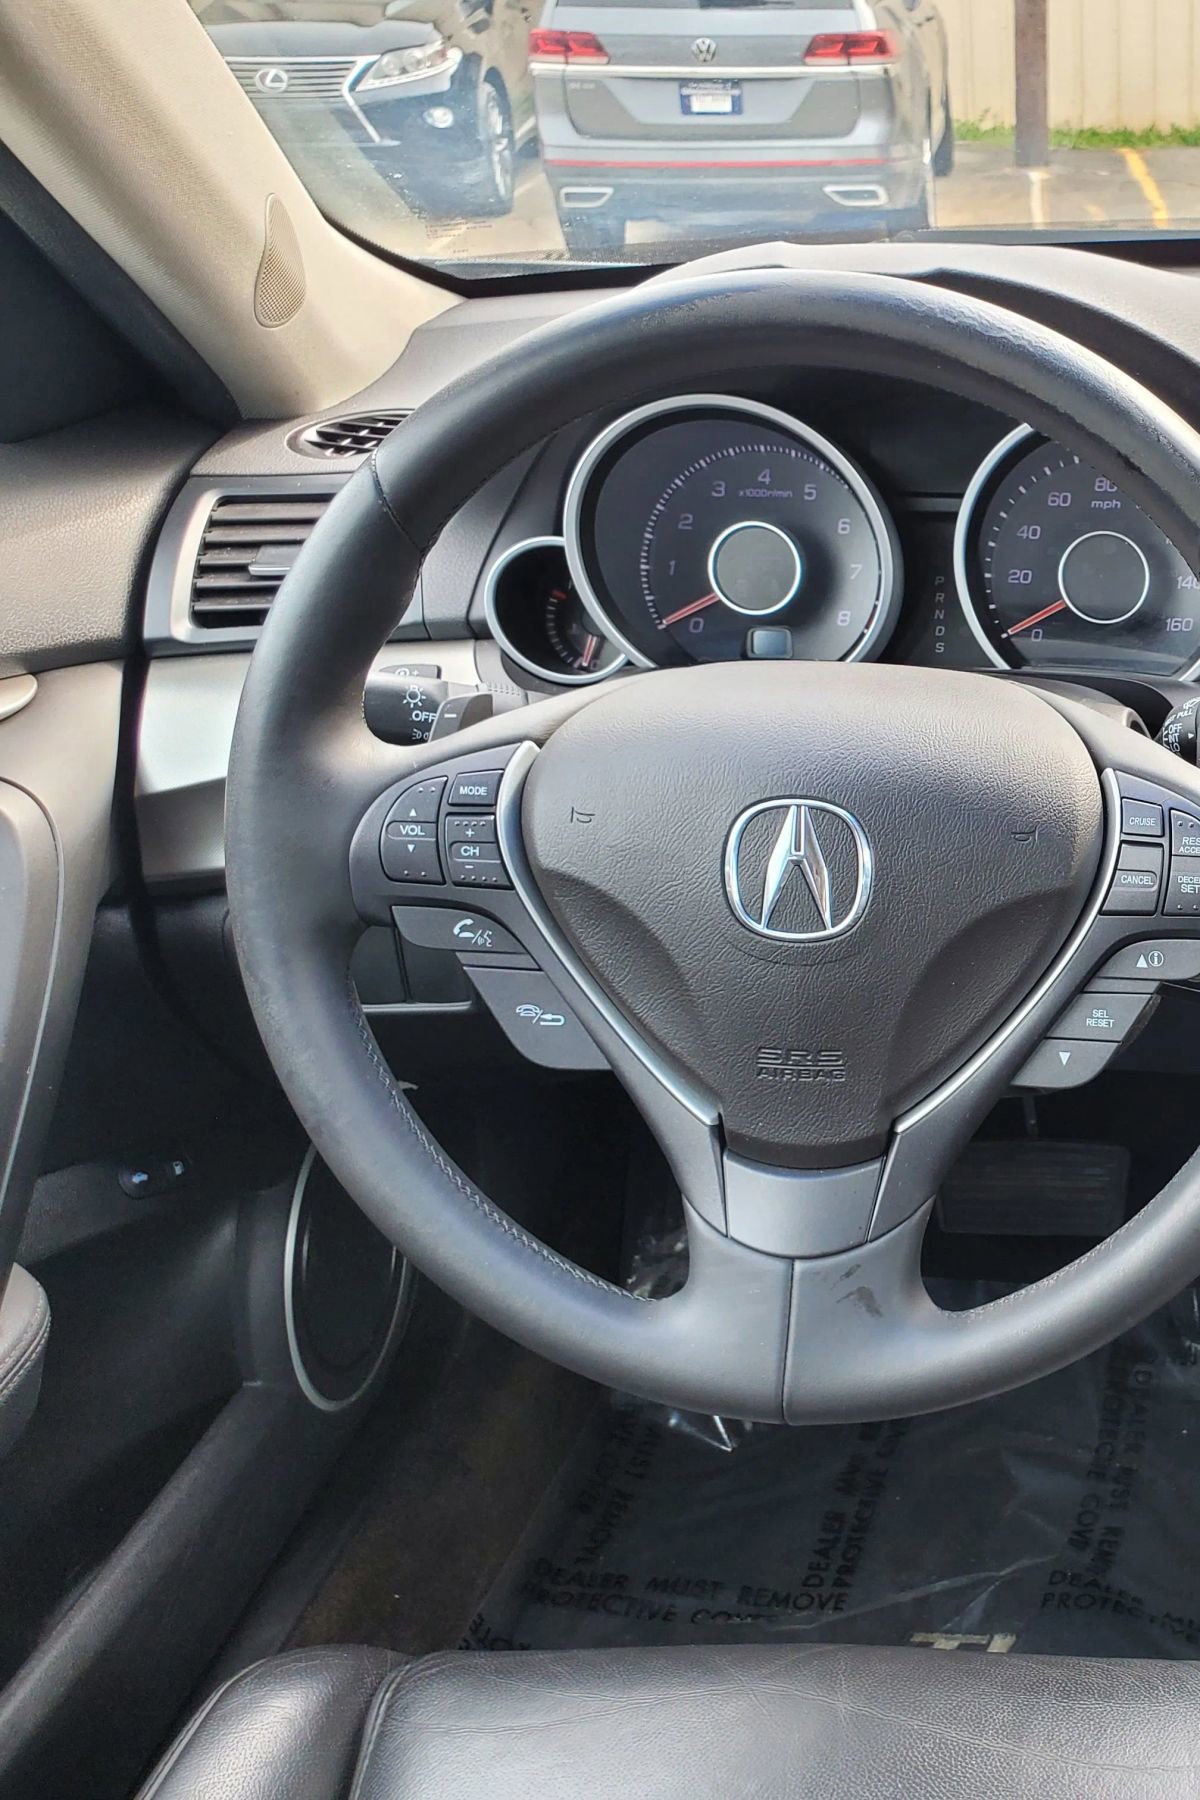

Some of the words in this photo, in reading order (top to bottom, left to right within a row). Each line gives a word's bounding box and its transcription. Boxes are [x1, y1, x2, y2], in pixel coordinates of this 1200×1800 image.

[757, 468, 771, 485] 4
[711, 481, 726, 498] 3
[803, 483, 818, 501] 5
[1047, 492, 1072, 507] 60
[1090, 498, 1121, 510] mph
[677, 513, 694, 530] 2
[837, 518, 851, 535] 6
[1016, 525, 1041, 540] 40
[668, 559, 677, 576] 1
[850, 564, 863, 580] 7
[1007, 570, 1033, 584] 20
[934, 593, 945, 604] R
[837, 610, 851, 627] 8
[934, 609, 945, 620] N
[688, 617, 704, 634] 0
[934, 626, 945, 636] D
[1165, 617, 1194, 632] 160
[1030, 628, 1043, 642] 0
[934, 643, 945, 653] S
[412, 710, 438, 723] OFF
[459, 785, 488, 796] MODE
[1128, 816, 1157, 827] CRUISE
[399, 825, 425, 836] VOL
[460, 846, 480, 857] CH
[1120, 874, 1155, 886] CANCEL
[1180, 884, 1200, 895] SET
[1091, 1009, 1110, 1019] SEL
[1086, 1018, 1116, 1028] RESET
[755, 1047, 847, 1066] SRS
[755, 1067, 848, 1083] AIRBAG
[646, 1575, 724, 1598] MUST
[736, 1585, 849, 1613] REMOVE
